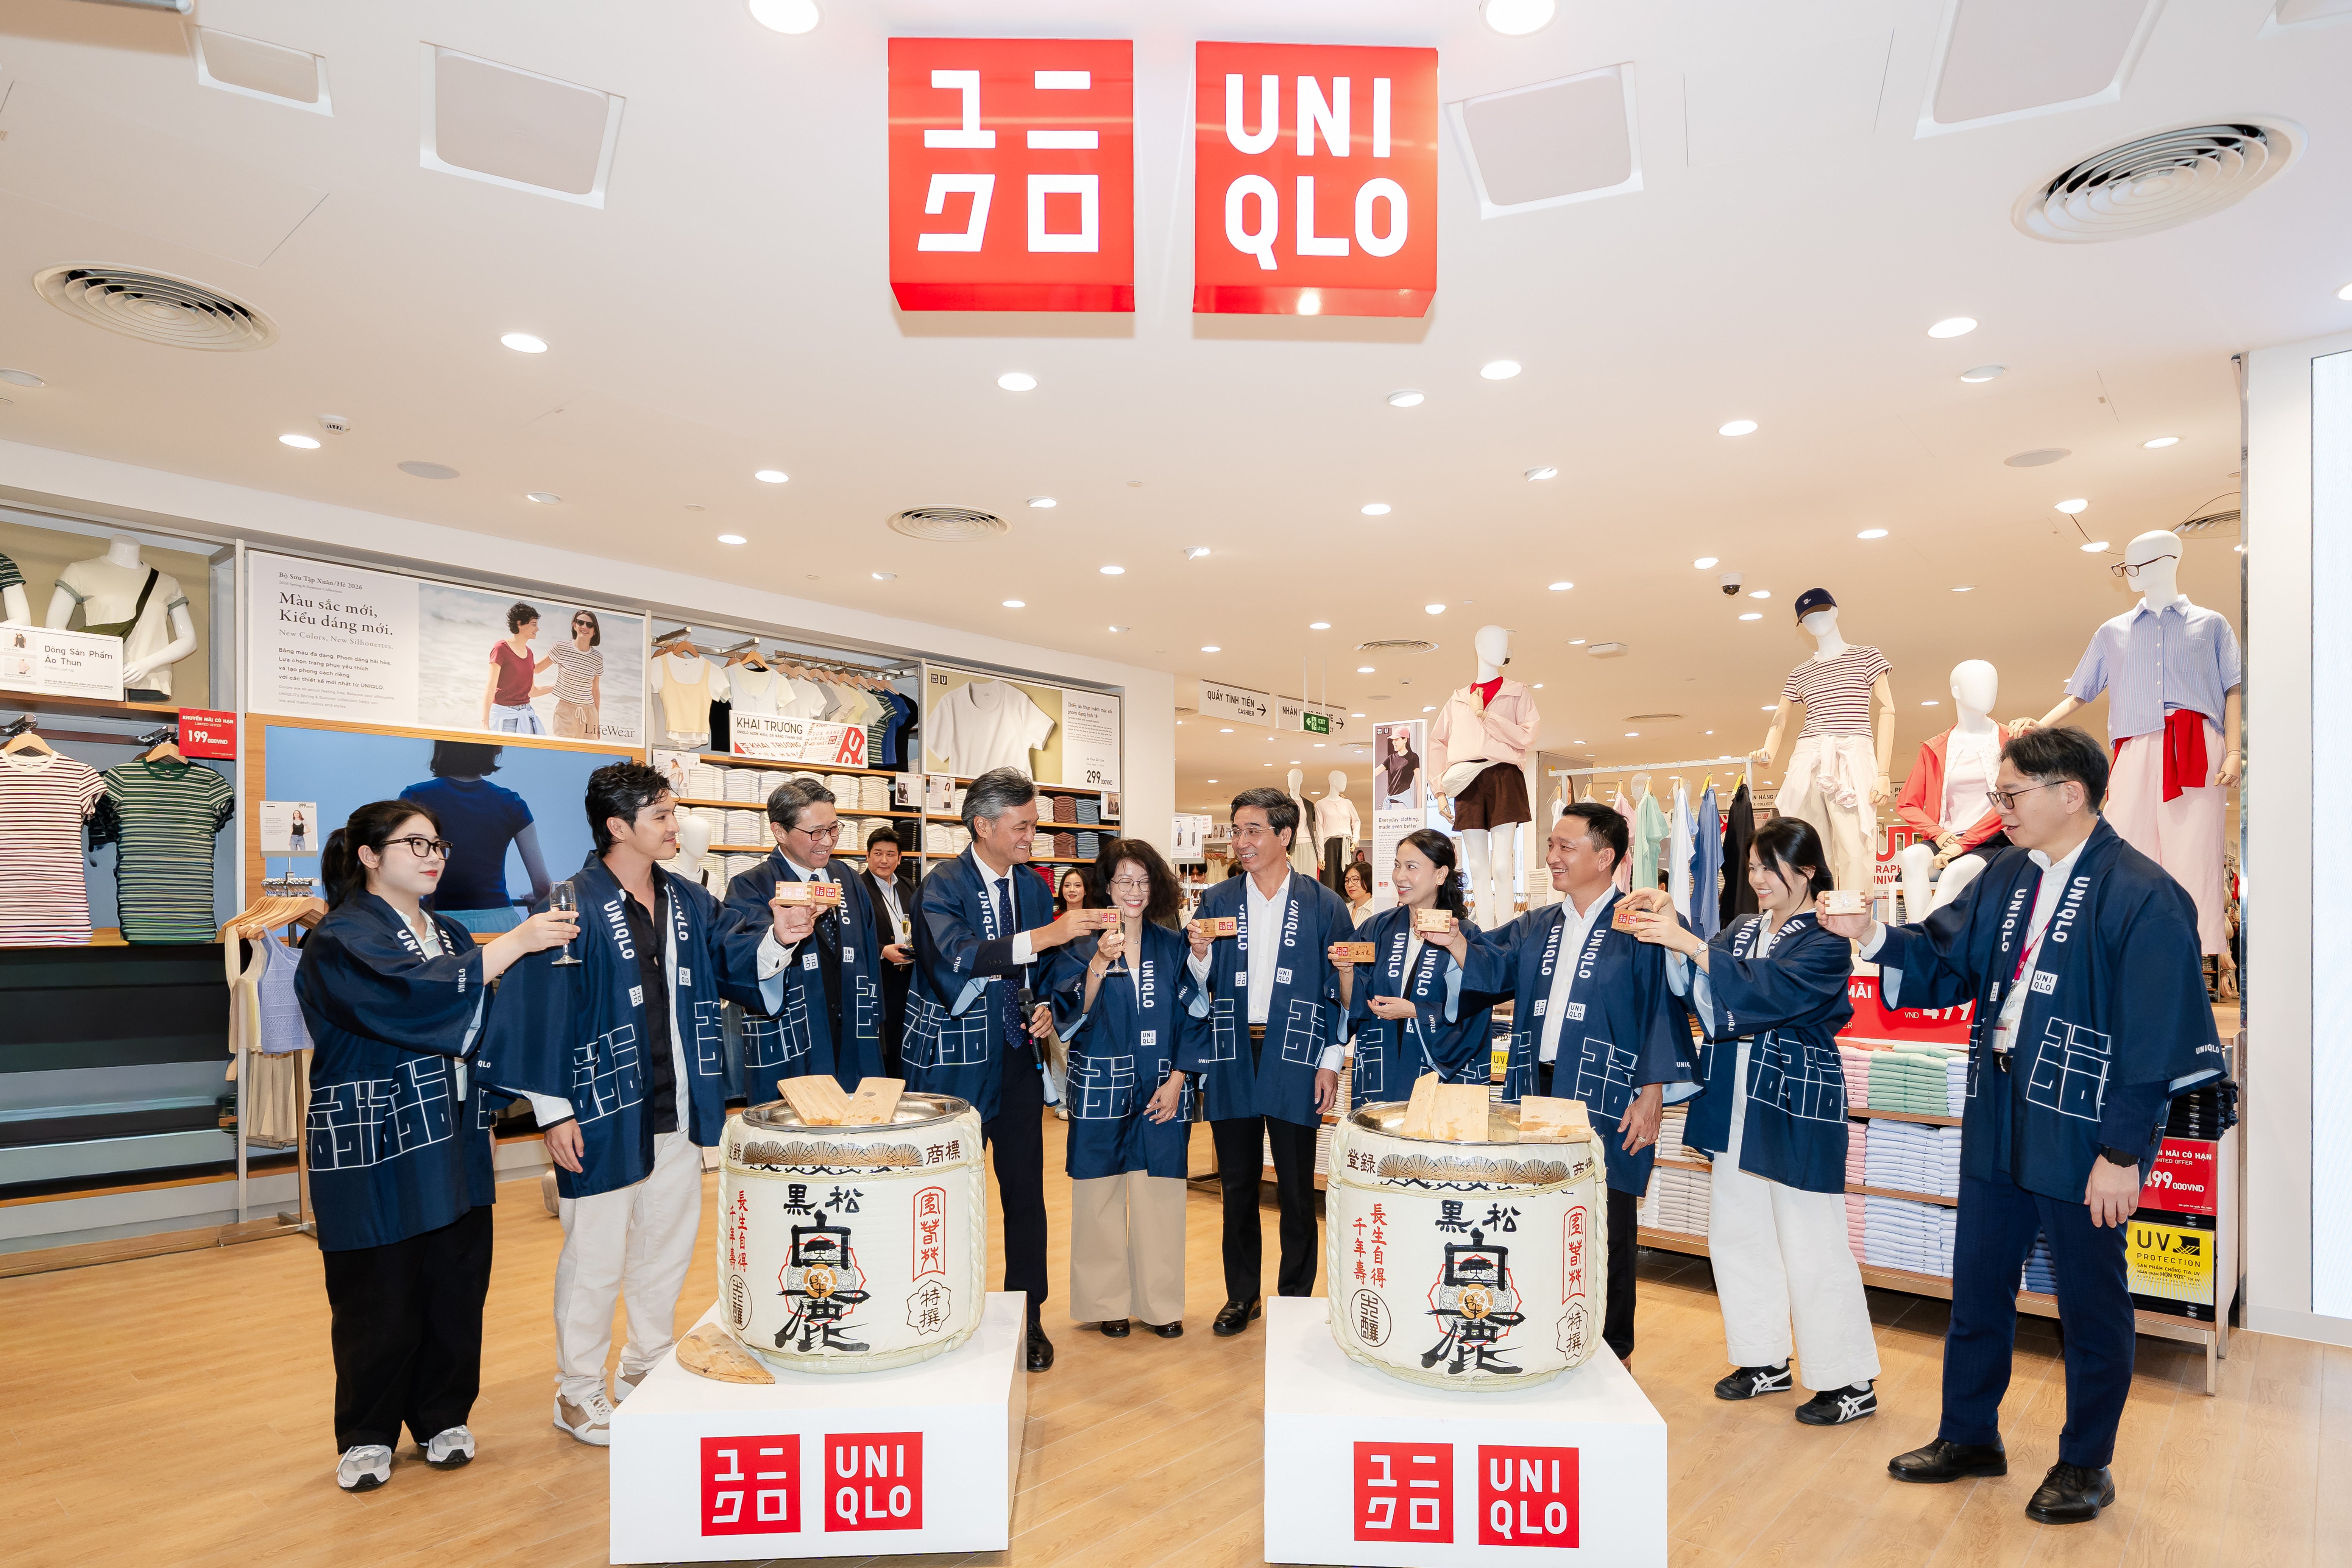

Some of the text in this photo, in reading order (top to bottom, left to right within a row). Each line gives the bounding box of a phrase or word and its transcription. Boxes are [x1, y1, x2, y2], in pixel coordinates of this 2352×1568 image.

[1225, 73, 1391, 158] UNI
[1224, 174, 1408, 270] QLO
[317, 578, 346, 587] Xuân/Hè
[279, 591, 377, 619] Màu sắc mới,
[279, 609, 393, 635] Kiểu dáng mới.
[45, 645, 66, 655] Dòng
[89, 651, 112, 659] Phẩm
[299, 632, 328, 642] Colors,
[330, 635, 347, 644] New
[349, 638, 393, 650] Silhouettes.
[45, 654, 81, 666] Áo Thun
[1207, 689, 1255, 708] QUẦY TÍNH TIỀN
[1238, 708, 1254, 717] CASHIER
[1282, 705, 1297, 718] NHẬN
[585, 723, 635, 738] LifeWear
[737, 717, 802, 734] KHAI TRƯƠNG
[1087, 770, 1101, 784] 299
[978, 891, 995, 941] UNIQLO
[1284, 900, 1299, 947] UNIQLO
[2001, 889, 2027, 952] UNIQLO
[2052, 877, 2091, 942] UNIQLO
[604, 900, 635, 960] UNIQLO
[1203, 921, 1209, 933] 白鹿
[1388, 933, 1407, 977] UNIQLO
[1541, 925, 1562, 975] UNIQLO
[1579, 930, 1606, 978] UNIQLO
[1141, 960, 1154, 1008] UNIQLO
[1416, 949, 1438, 996] UNIQLO
[2034, 981, 2051, 991] QLO
[2036, 974, 2053, 983] UNI
[2196, 1044, 2219, 1055] UNIQLO
[926, 1140, 960, 1165] 商標
[1347, 1148, 1376, 1174] 登録
[2195, 1153, 2212, 1161] HẠN
[784, 1184, 864, 1215] 黒松
[737, 1189, 748, 1274] 長生自得
[1435, 1200, 1522, 1233] 黒松
[1369, 1203, 1387, 1289] 長生自得
[2137, 1229, 2171, 1251] UV
[2137, 1253, 2201, 1267] PROTECTION
[919, 1287, 940, 1328] 特撰
[1566, 1312, 1583, 1353] 特撰
[835, 1445, 904, 1478] UNI
[1490, 1458, 1560, 1493] UNI
[835, 1485, 911, 1526] QLO
[1490, 1499, 1567, 1540] QLO
